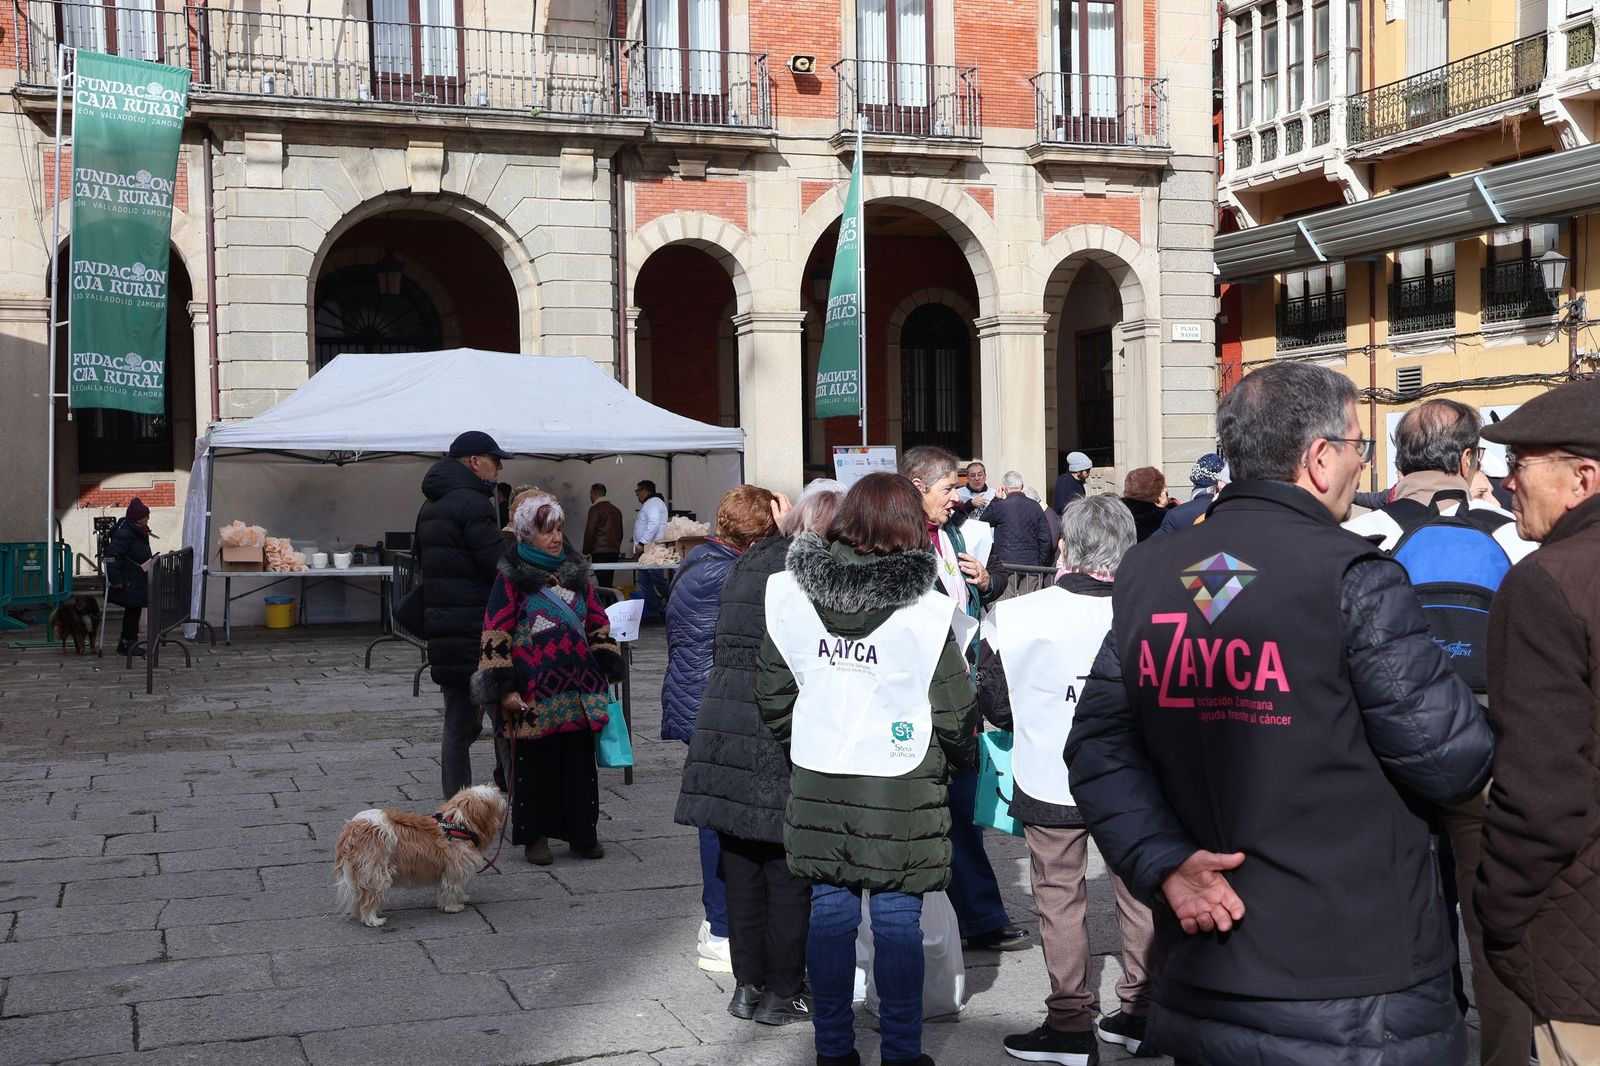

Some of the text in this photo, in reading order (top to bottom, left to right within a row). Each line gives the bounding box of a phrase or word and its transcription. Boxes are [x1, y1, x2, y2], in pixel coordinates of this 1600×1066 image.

[77, 90, 184, 120] CAJA RURAL
[101, 111, 146, 124] VALLADOLID
[151, 118, 183, 130] ZAMORA
[92, 201, 139, 215] VALLADOLID
[117, 189, 172, 209] RURAL
[110, 279, 166, 299] RURAL
[85, 292, 134, 307] VALLADOLID
[136, 300, 166, 310] ZAMORA
[103, 369, 163, 388] RURAL
[132, 390, 163, 399] ZAMORA
[1138, 612, 1291, 708] AZAYCA
[1259, 714, 1292, 725] cáncer
